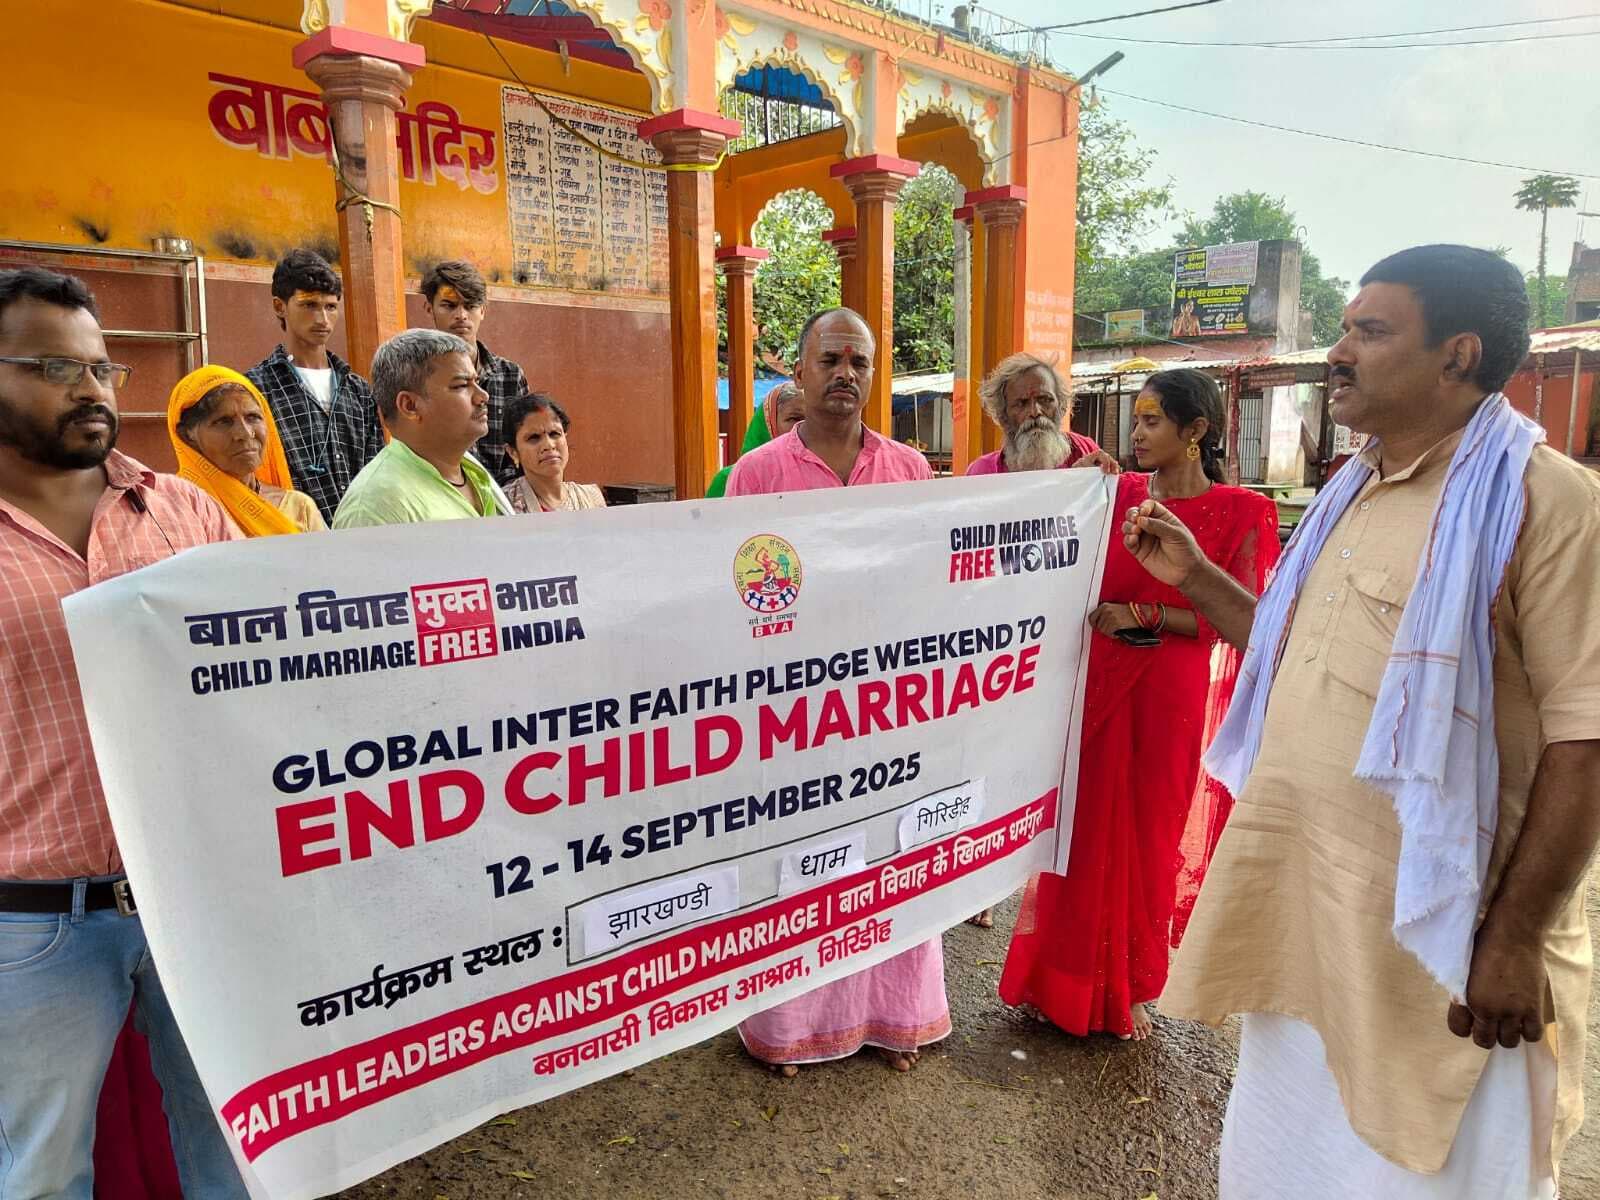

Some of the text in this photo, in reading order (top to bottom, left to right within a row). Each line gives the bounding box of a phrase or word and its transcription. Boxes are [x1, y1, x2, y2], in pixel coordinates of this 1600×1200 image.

[207, 71, 335, 167] बाब
[949, 539, 1080, 583] FREE WORLD
[950, 515, 1077, 552] CHILD MARRIAGE
[185, 575, 578, 647] बाल विवाह मुक्त भारत
[191, 616, 586, 695] CHILD MARRIAGE FREE INDIA
[272, 615, 1046, 794] GLOBAL INTER FAITH PLEDGE WEEKEND TO
[275, 645, 1041, 877] END CHILD MARRIAGE
[486, 753, 921, 898] 12 - 14 SEPTEMBER 2025
[838, 881, 876, 914] बाल
[880, 858, 929, 901] विवाह
[932, 846, 949, 876] के
[953, 824, 1006, 869] खिलाफ
[297, 955, 453, 1028] कार्यक्रम
[462, 926, 546, 977] स्थल
[607, 883, 712, 940] झारखण्डी
[801, 844, 852, 877] धाम
[916, 796, 972, 832] गिरिडीह
[231, 1078, 331, 1146] FAITH
[337, 1024, 485, 1102] LEADERS
[490, 975, 618, 1041] AGAINST
[622, 945, 697, 997] CHILD
[701, 902, 819, 966] MARRIAGE
[533, 919, 894, 1078] बनवासी विकास आश्रम, गिरिडीह
